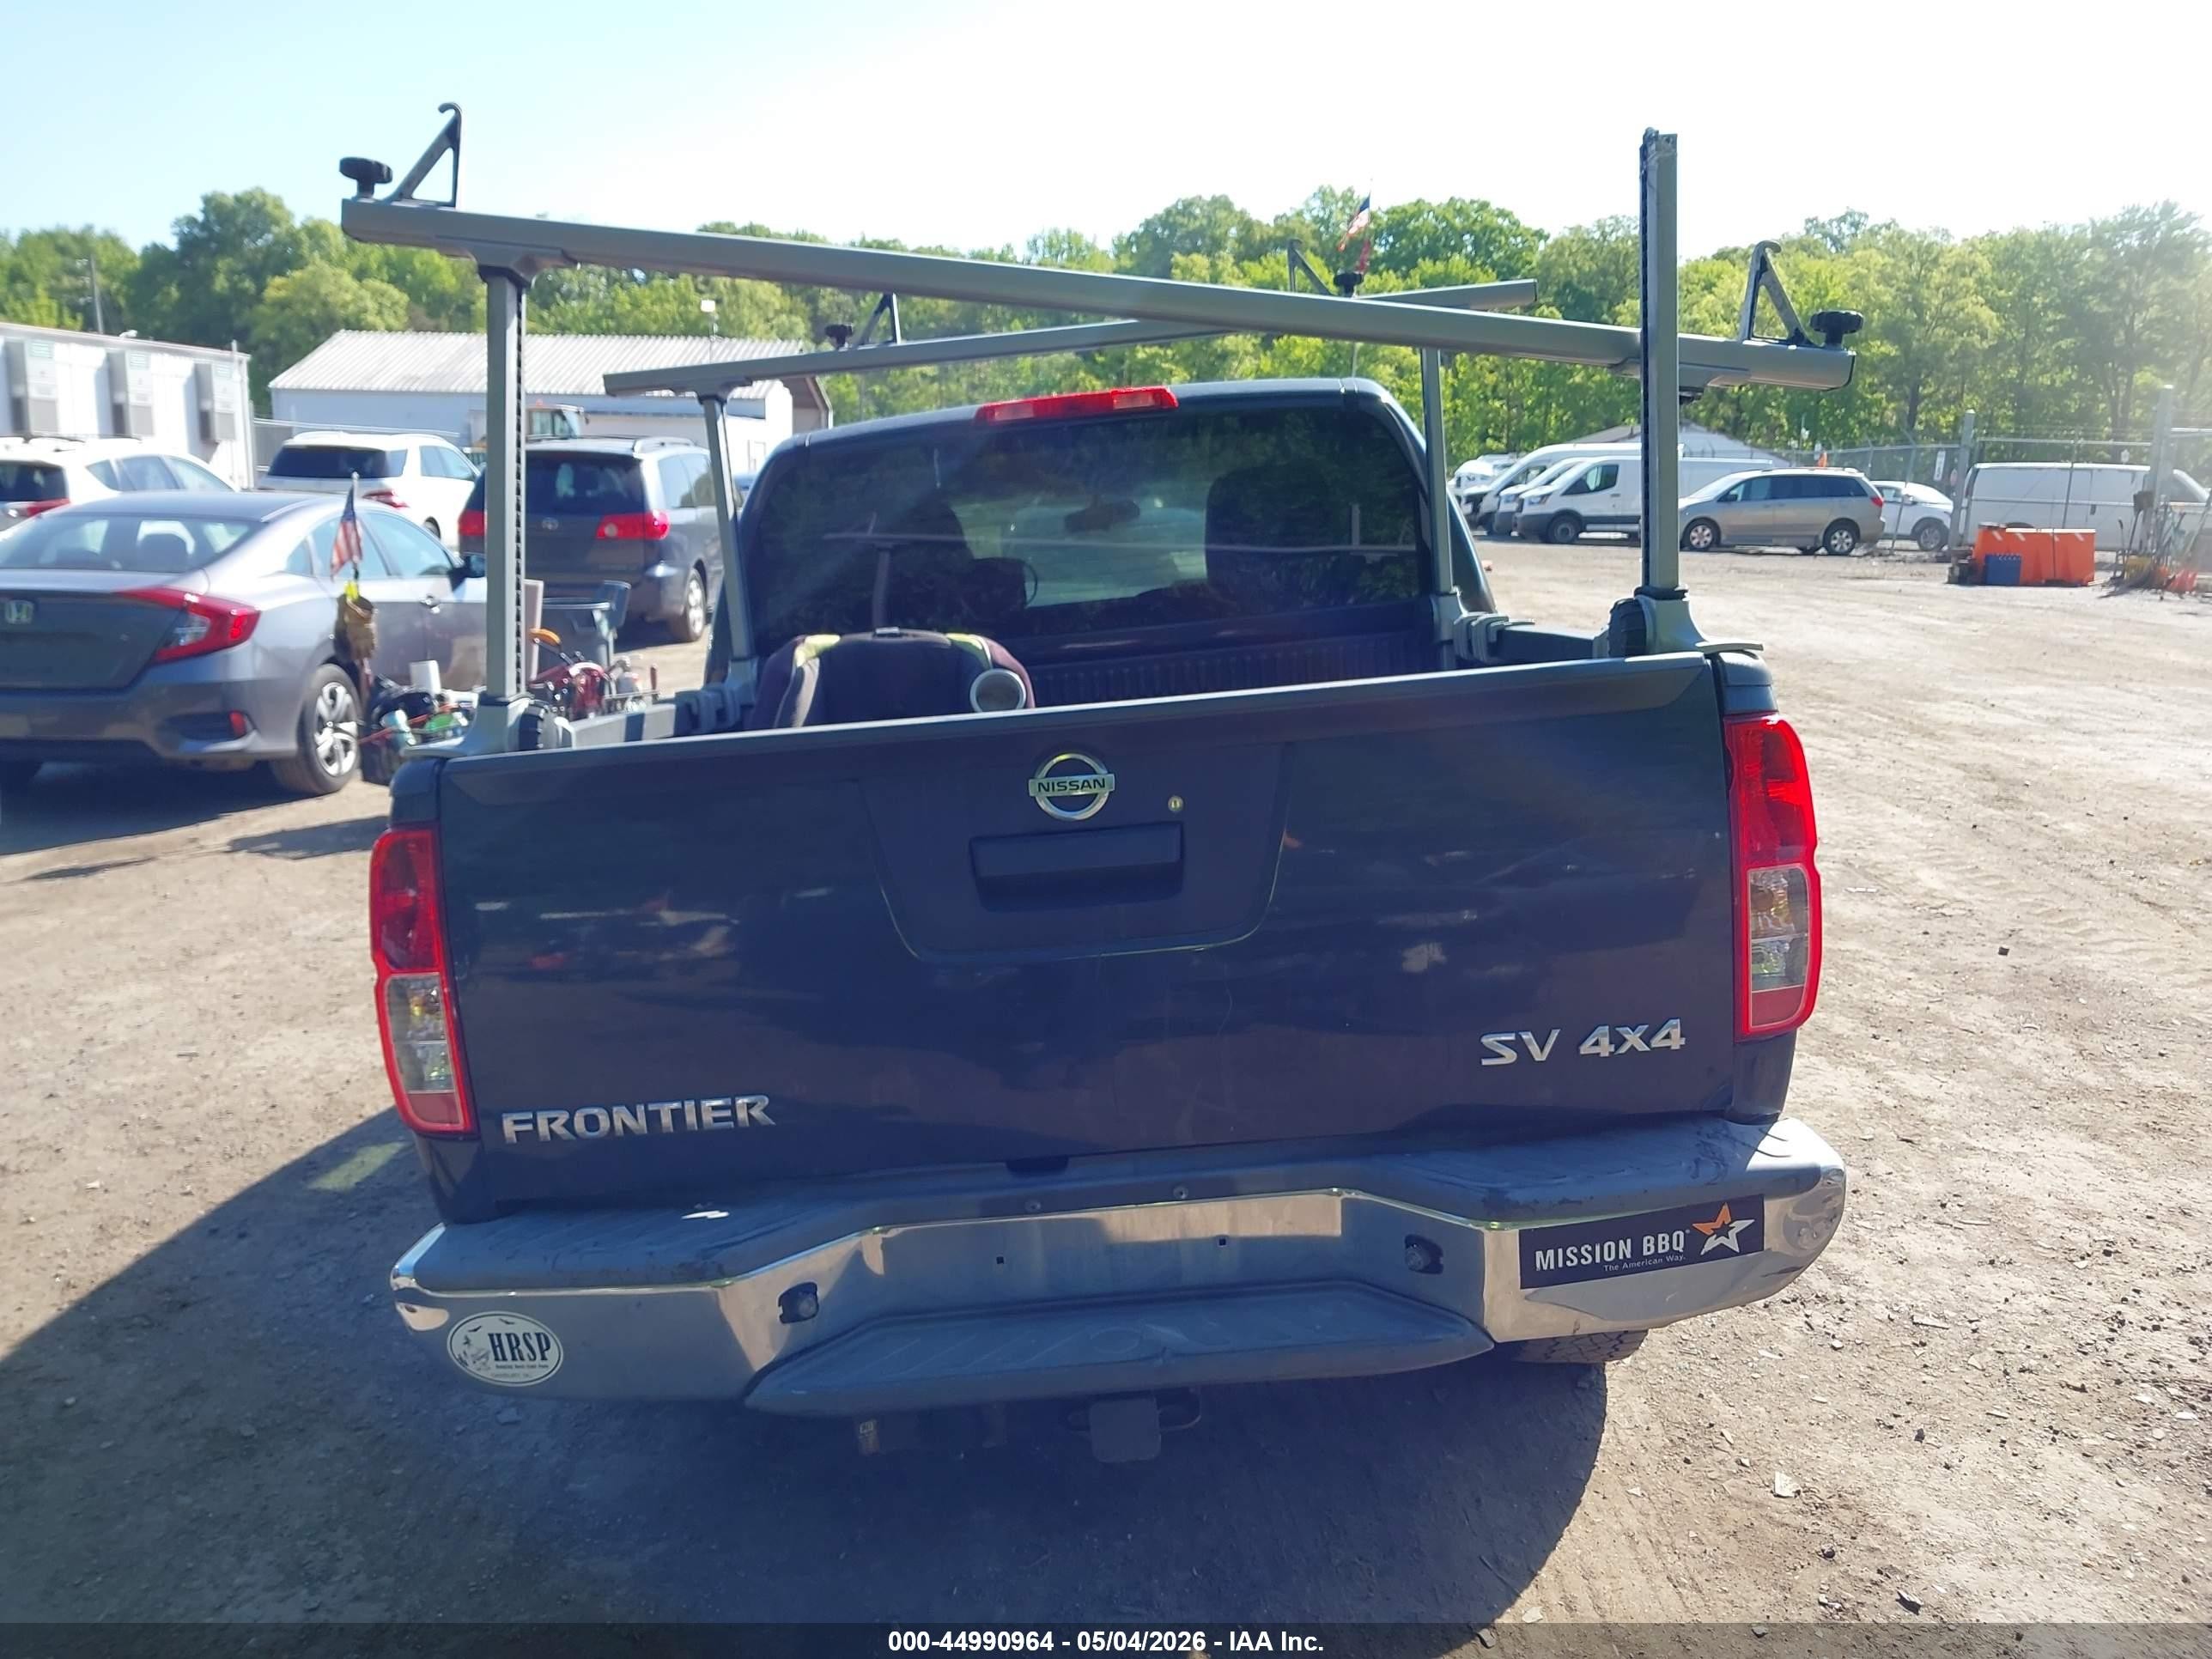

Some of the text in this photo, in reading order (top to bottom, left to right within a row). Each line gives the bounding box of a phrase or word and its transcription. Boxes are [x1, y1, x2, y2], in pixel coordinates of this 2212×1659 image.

[1037, 778, 1106, 793] NISSAN
[1480, 1029, 1562, 1066] SV
[501, 1094, 776, 1144] FRONTIER
[1534, 1238, 1632, 1272] MISSION
[1621, 1257, 1663, 1270] American
[1665, 1254, 1686, 1263] Way.
[487, 1332, 552, 1362] HRSP
